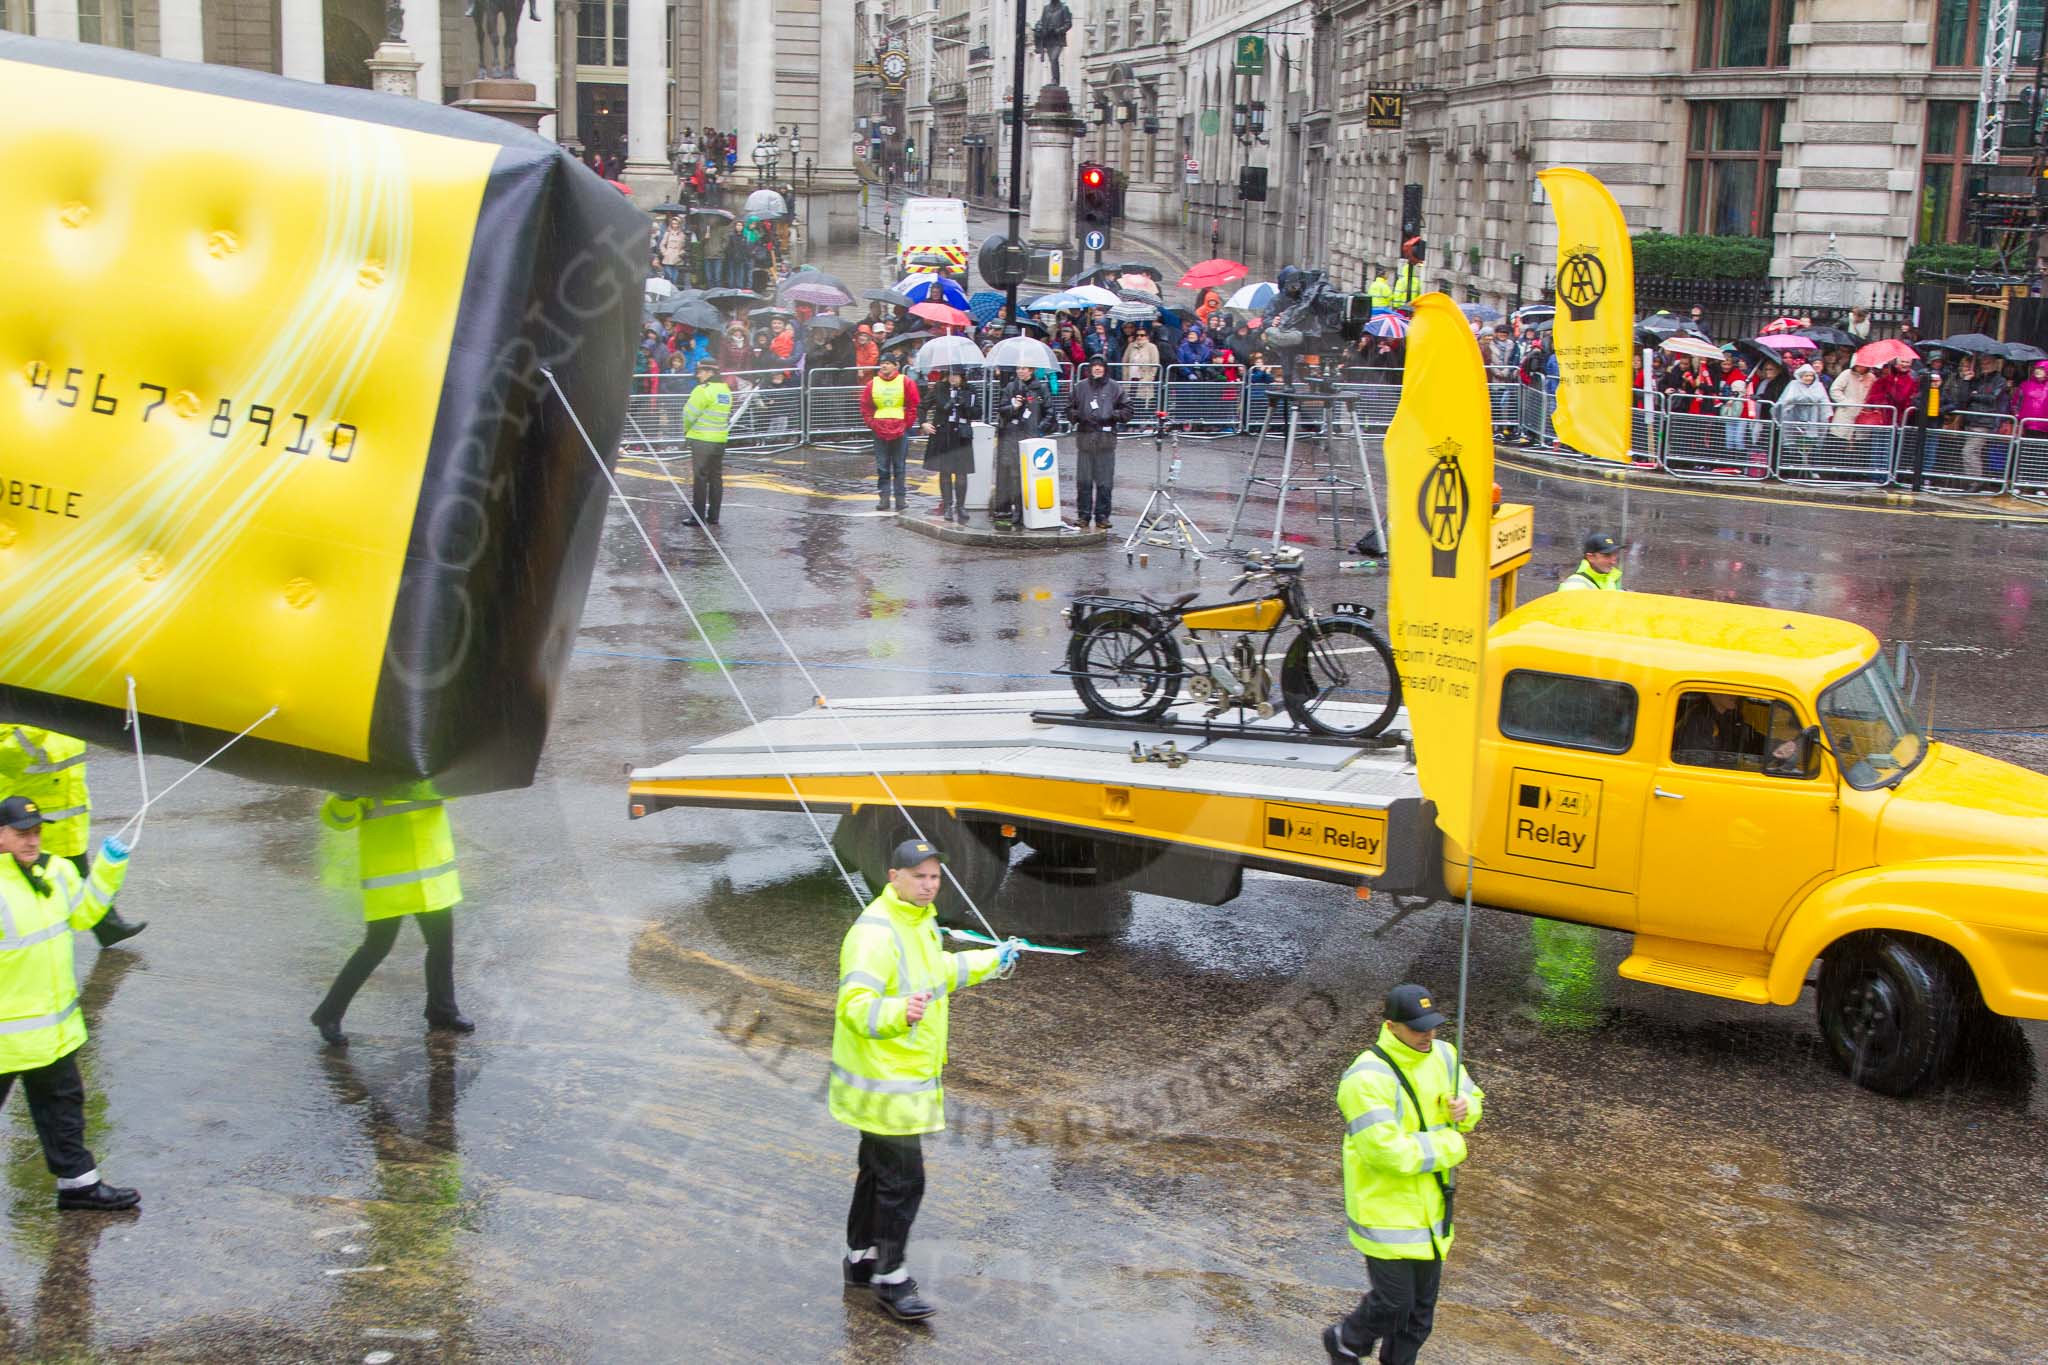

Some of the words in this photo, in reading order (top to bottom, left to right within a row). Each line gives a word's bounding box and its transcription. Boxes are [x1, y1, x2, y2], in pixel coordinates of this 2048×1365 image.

[0, 476, 83, 519] BILE
[1496, 524, 1528, 550] Service
[1336, 604, 1355, 614] AA
[1359, 606, 1368, 616] 2
[1322, 826, 1380, 855] Relay
[1517, 818, 1586, 854] Relay
